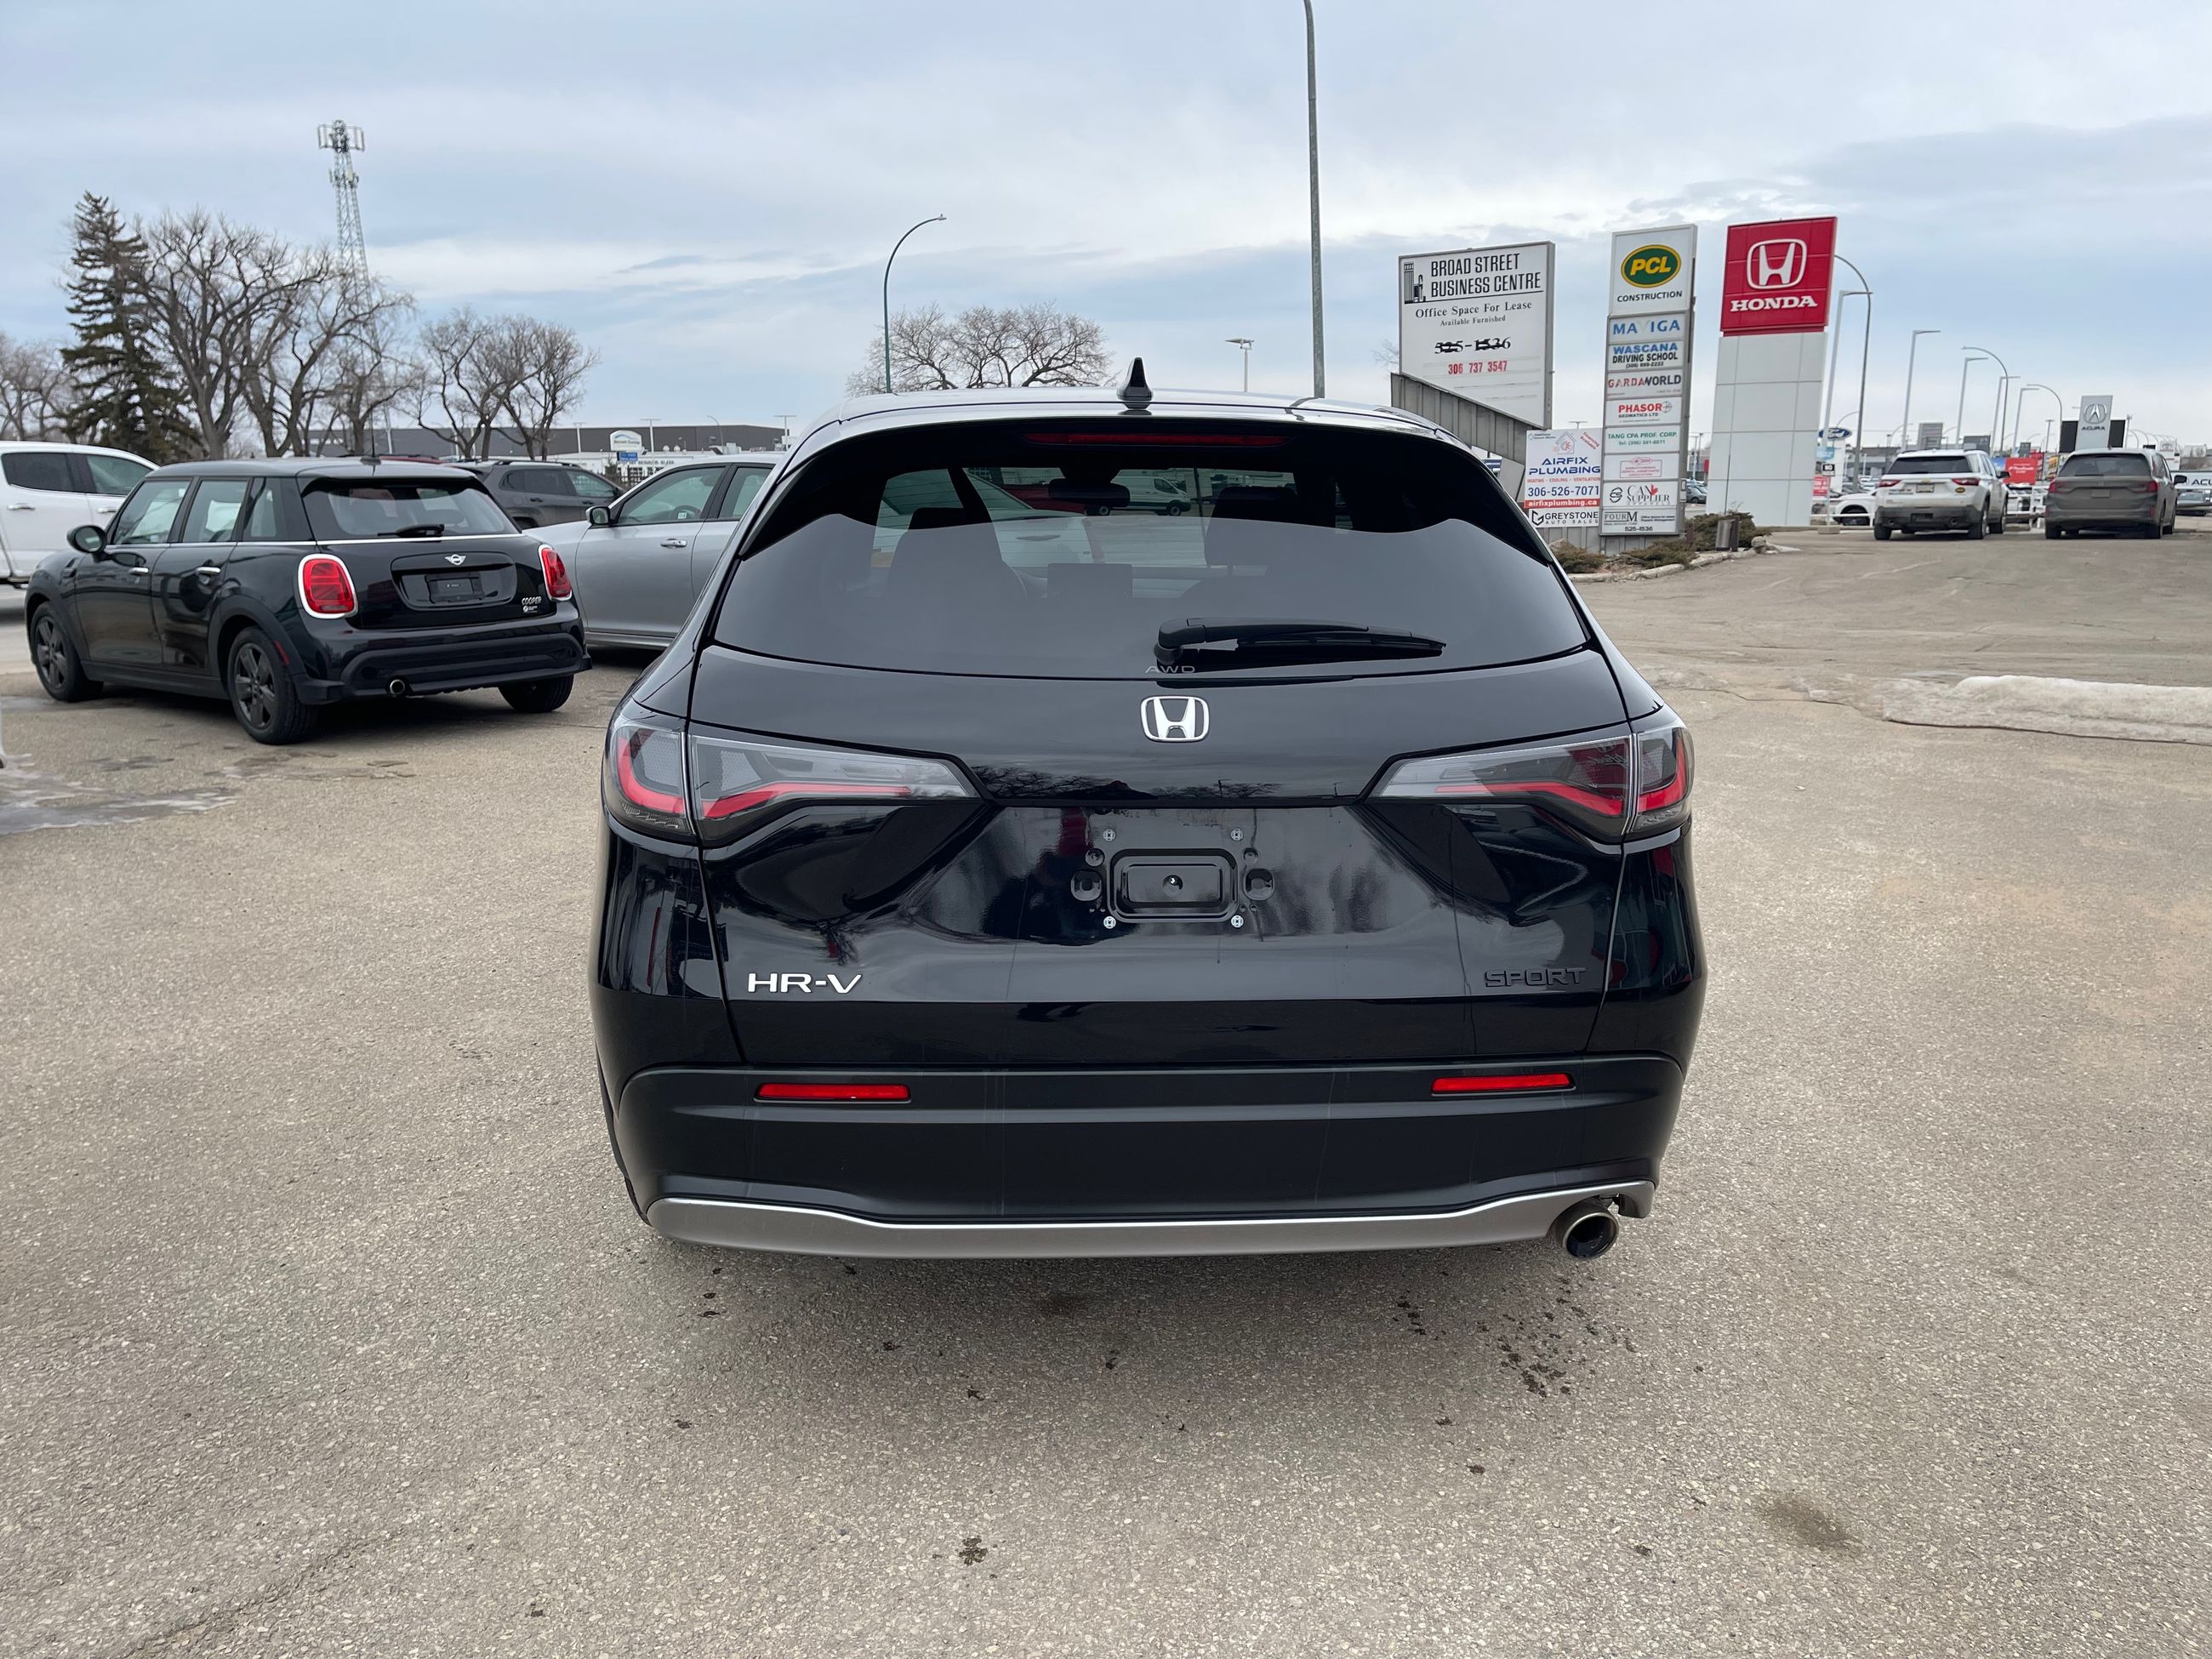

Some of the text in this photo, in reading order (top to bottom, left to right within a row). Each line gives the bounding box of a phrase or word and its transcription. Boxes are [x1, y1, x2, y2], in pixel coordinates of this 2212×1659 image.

[1431, 253, 1520, 277] BROAD STREET
[1630, 256, 1672, 276] PCL
[1431, 271, 1541, 298] BUSINESS CENTRE
[1616, 290, 1683, 302] CONSTRUCTION
[1415, 301, 1532, 318] Office Space For Lease
[1730, 295, 1818, 312] HONDA
[1440, 315, 1506, 327] Available Furnished
[1613, 320, 1680, 334] MAIGA
[1613, 342, 1678, 355] WASCANA
[1612, 351, 1679, 363] DRIVING SCHOOL
[1448, 360, 1508, 374] 306 737 3547
[1618, 402, 1662, 413] PHASOR
[1542, 457, 1588, 465] AIRFIX
[1529, 466, 1601, 476] PLUMBING
[1528, 486, 1599, 497] 306-526-7071
[1545, 511, 1599, 520] GREYSTONE
[522, 596, 542, 605] COOPER
[1144, 665, 1196, 674] AWD
[747, 972, 862, 994] HR-V
[1485, 967, 1587, 987] SPORT
